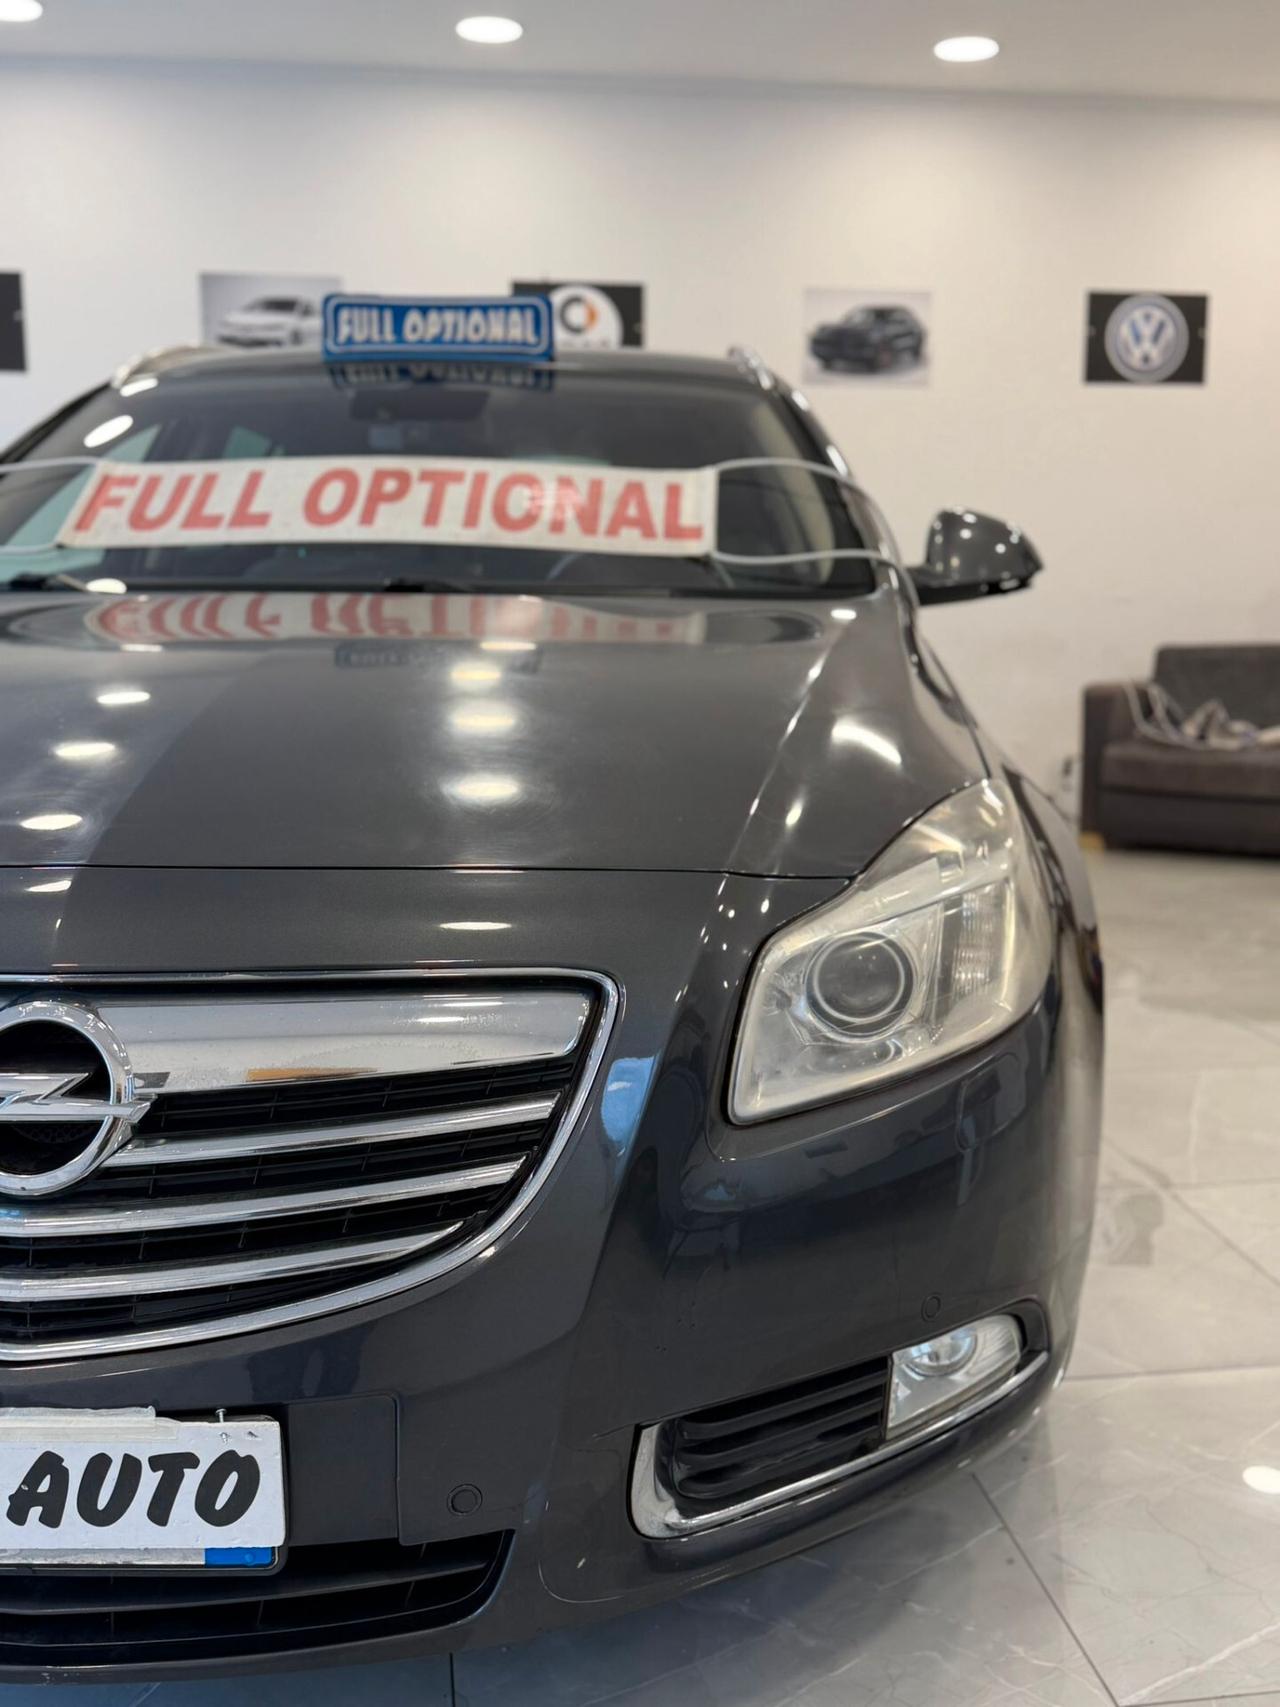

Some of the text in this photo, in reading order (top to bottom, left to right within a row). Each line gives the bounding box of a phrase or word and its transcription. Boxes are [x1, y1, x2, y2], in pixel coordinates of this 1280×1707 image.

[336, 306, 539, 345] FULL OPTIONAL
[74, 468, 705, 540] FULL OPTIONAL
[6, 1450, 260, 1528] AUTO
